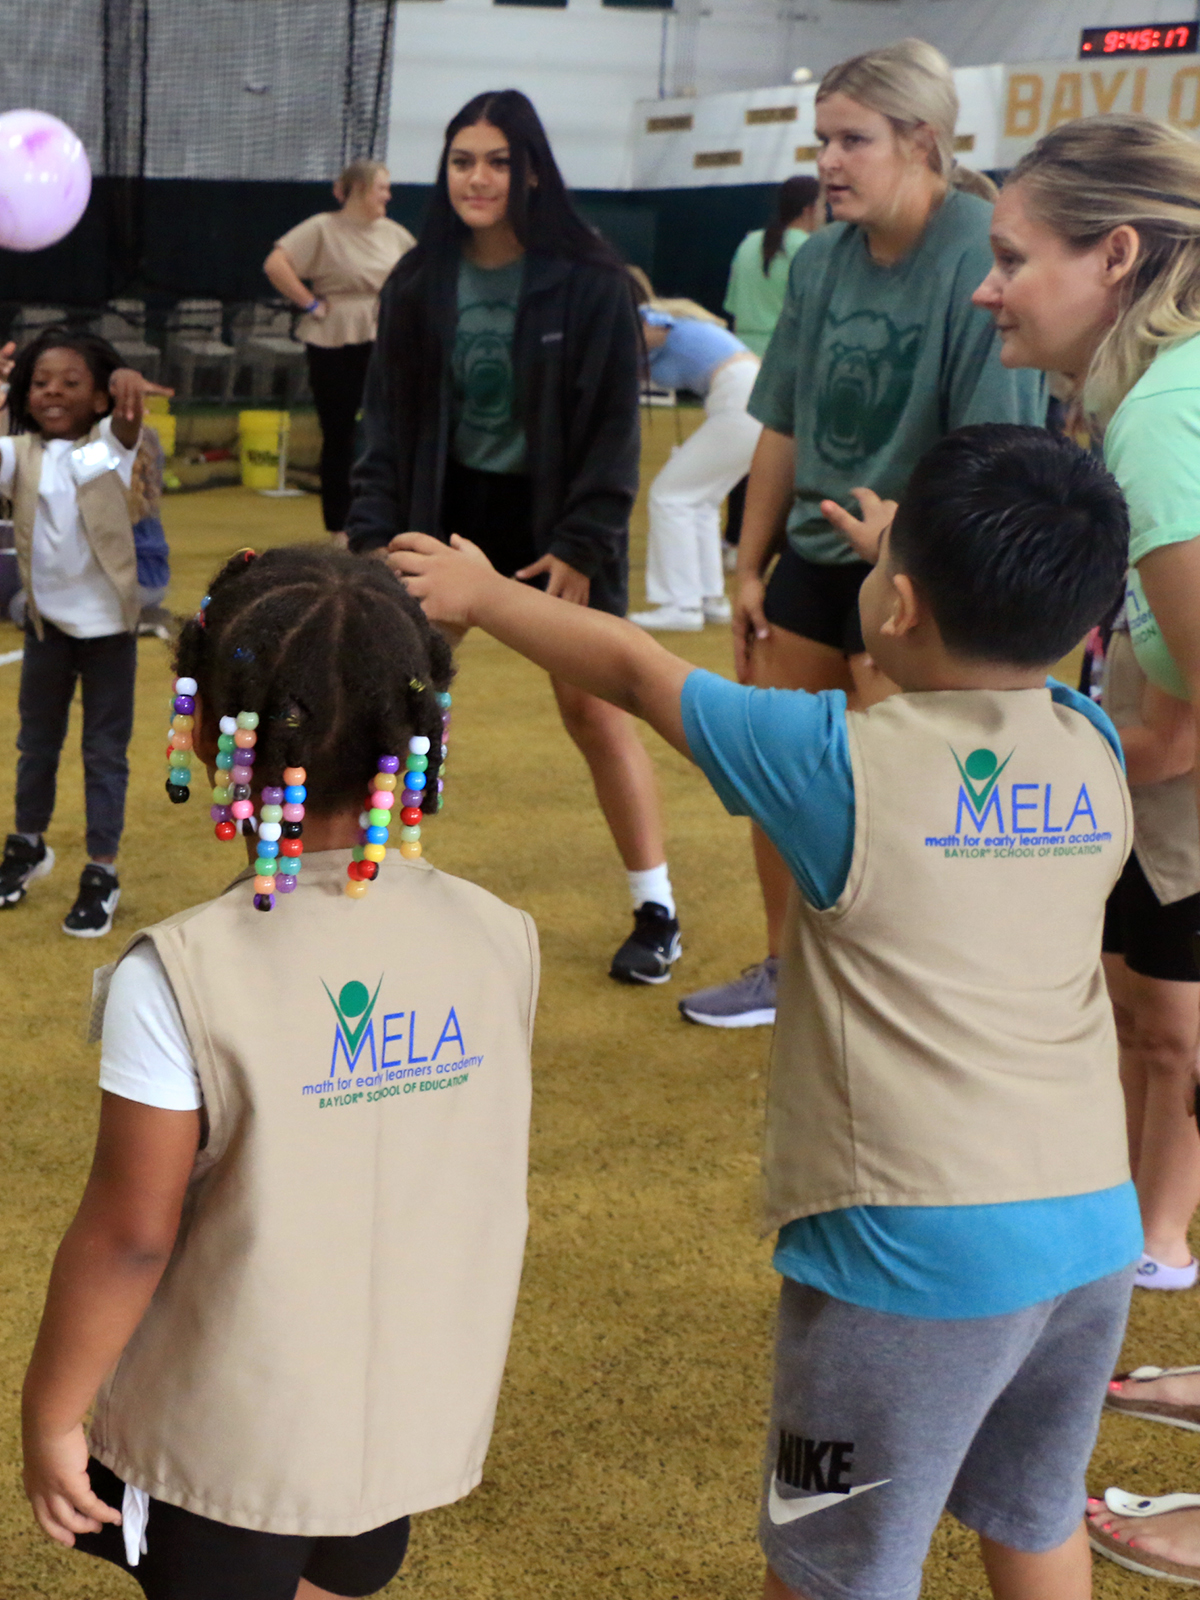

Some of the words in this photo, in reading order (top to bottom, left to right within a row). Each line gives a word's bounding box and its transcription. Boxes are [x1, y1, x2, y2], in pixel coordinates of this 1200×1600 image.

[1103, 26, 1190, 52] 9:45:17
[955, 782, 1098, 834] MELA
[925, 835, 960, 847] math
[963, 834, 981, 847] for
[984, 834, 1016, 849] early
[1019, 833, 1065, 846] learners
[994, 847, 1035, 858] SCHOOL
[1038, 847, 1052, 858] OF
[1053, 845, 1102, 857] EDUCATION
[329, 1005, 466, 1078] MELA
[302, 1078, 335, 1096] math
[337, 1077, 353, 1091] for
[356, 1071, 384, 1087] early
[385, 1064, 432, 1082] learners
[435, 1054, 485, 1074] academy
[403, 1081, 417, 1094] OF
[419, 1072, 469, 1093] EDUCATION
[775, 1429, 855, 1495] NIKE
